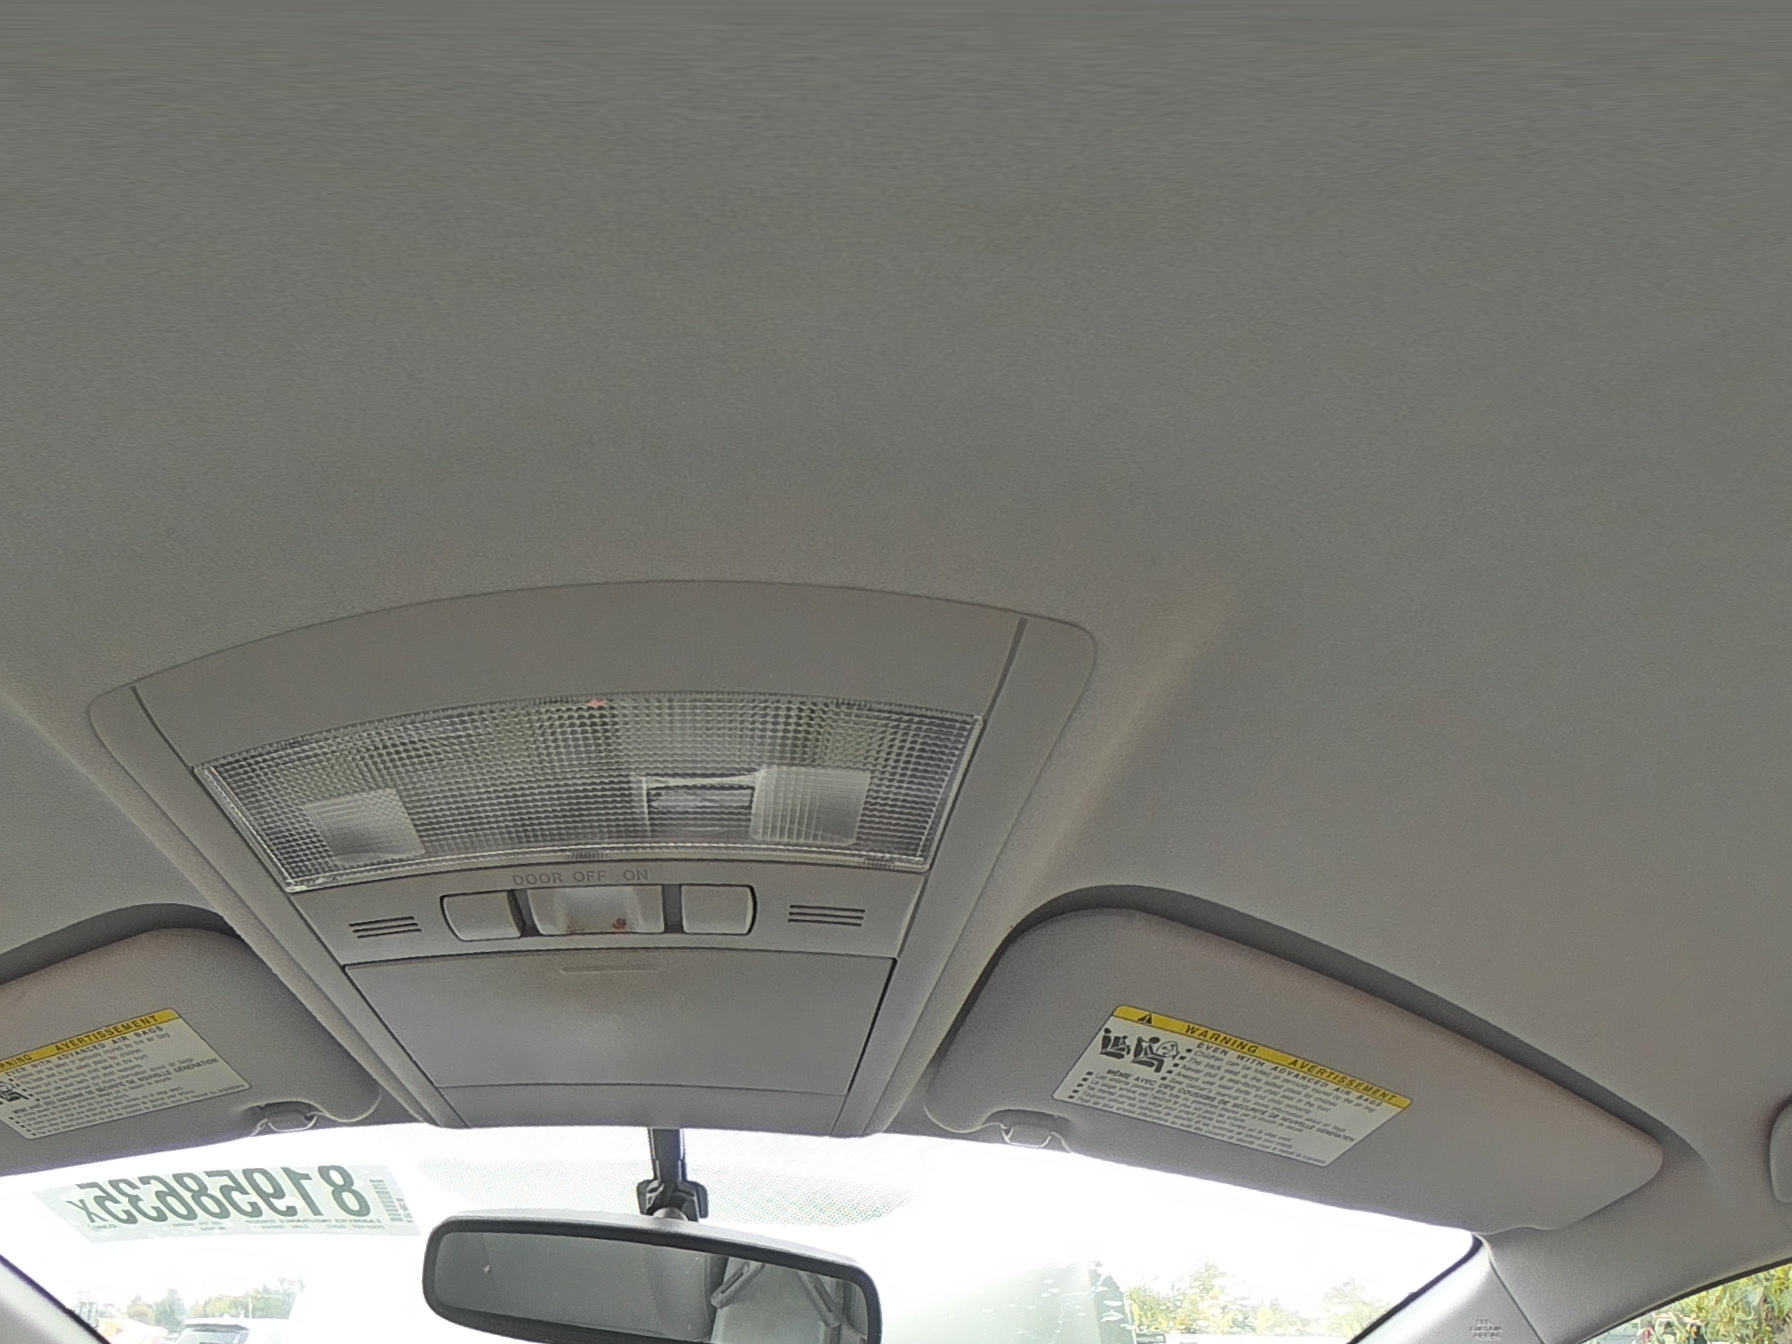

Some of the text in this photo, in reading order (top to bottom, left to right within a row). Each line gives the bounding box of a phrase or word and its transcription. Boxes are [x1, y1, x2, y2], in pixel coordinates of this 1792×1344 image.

[513, 869, 649, 886] DOOR OFF ON
[54, 1015, 158, 1051] AVERTISSEMENT
[57, 1042, 106, 1061] ADVANCED
[111, 1035, 129, 1045] AIR
[136, 1026, 163, 1038] BAGS
[1184, 1024, 1399, 1101] WARNING AVERTISSEMENT
[1196, 1042, 1229, 1056] EVEN
[1236, 1053, 1265, 1067] WITH
[1270, 1065, 1328, 1088] ADVANCED
[1333, 1086, 1352, 1097] AIR
